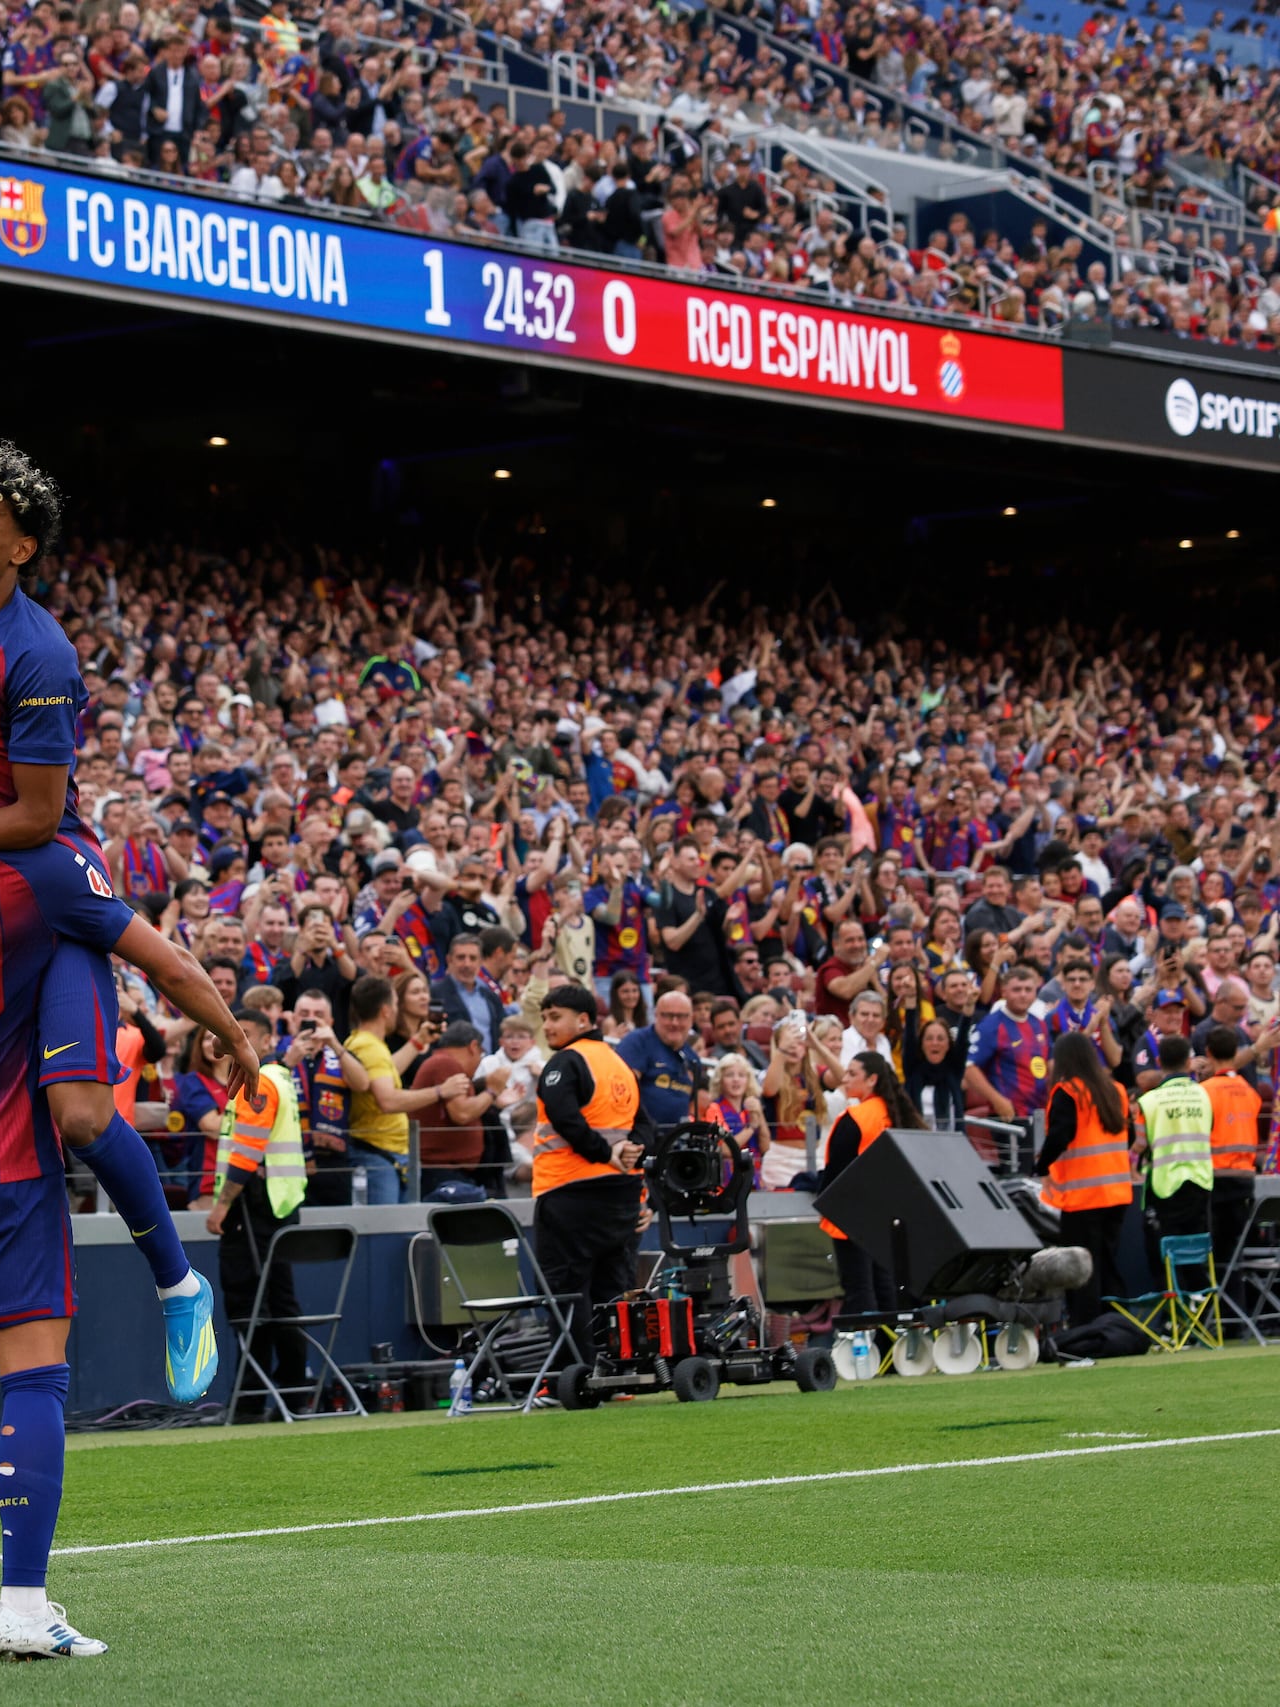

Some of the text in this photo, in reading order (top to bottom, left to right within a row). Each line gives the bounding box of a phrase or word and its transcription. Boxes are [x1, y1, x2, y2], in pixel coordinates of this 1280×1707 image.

[66, 188, 917, 396] FC BARCELONA 1 24:32 0 RCD ESPANYOL
[1201, 392, 1280, 438] SPOTIF
[18, 696, 66, 708] AMBILIGHT
